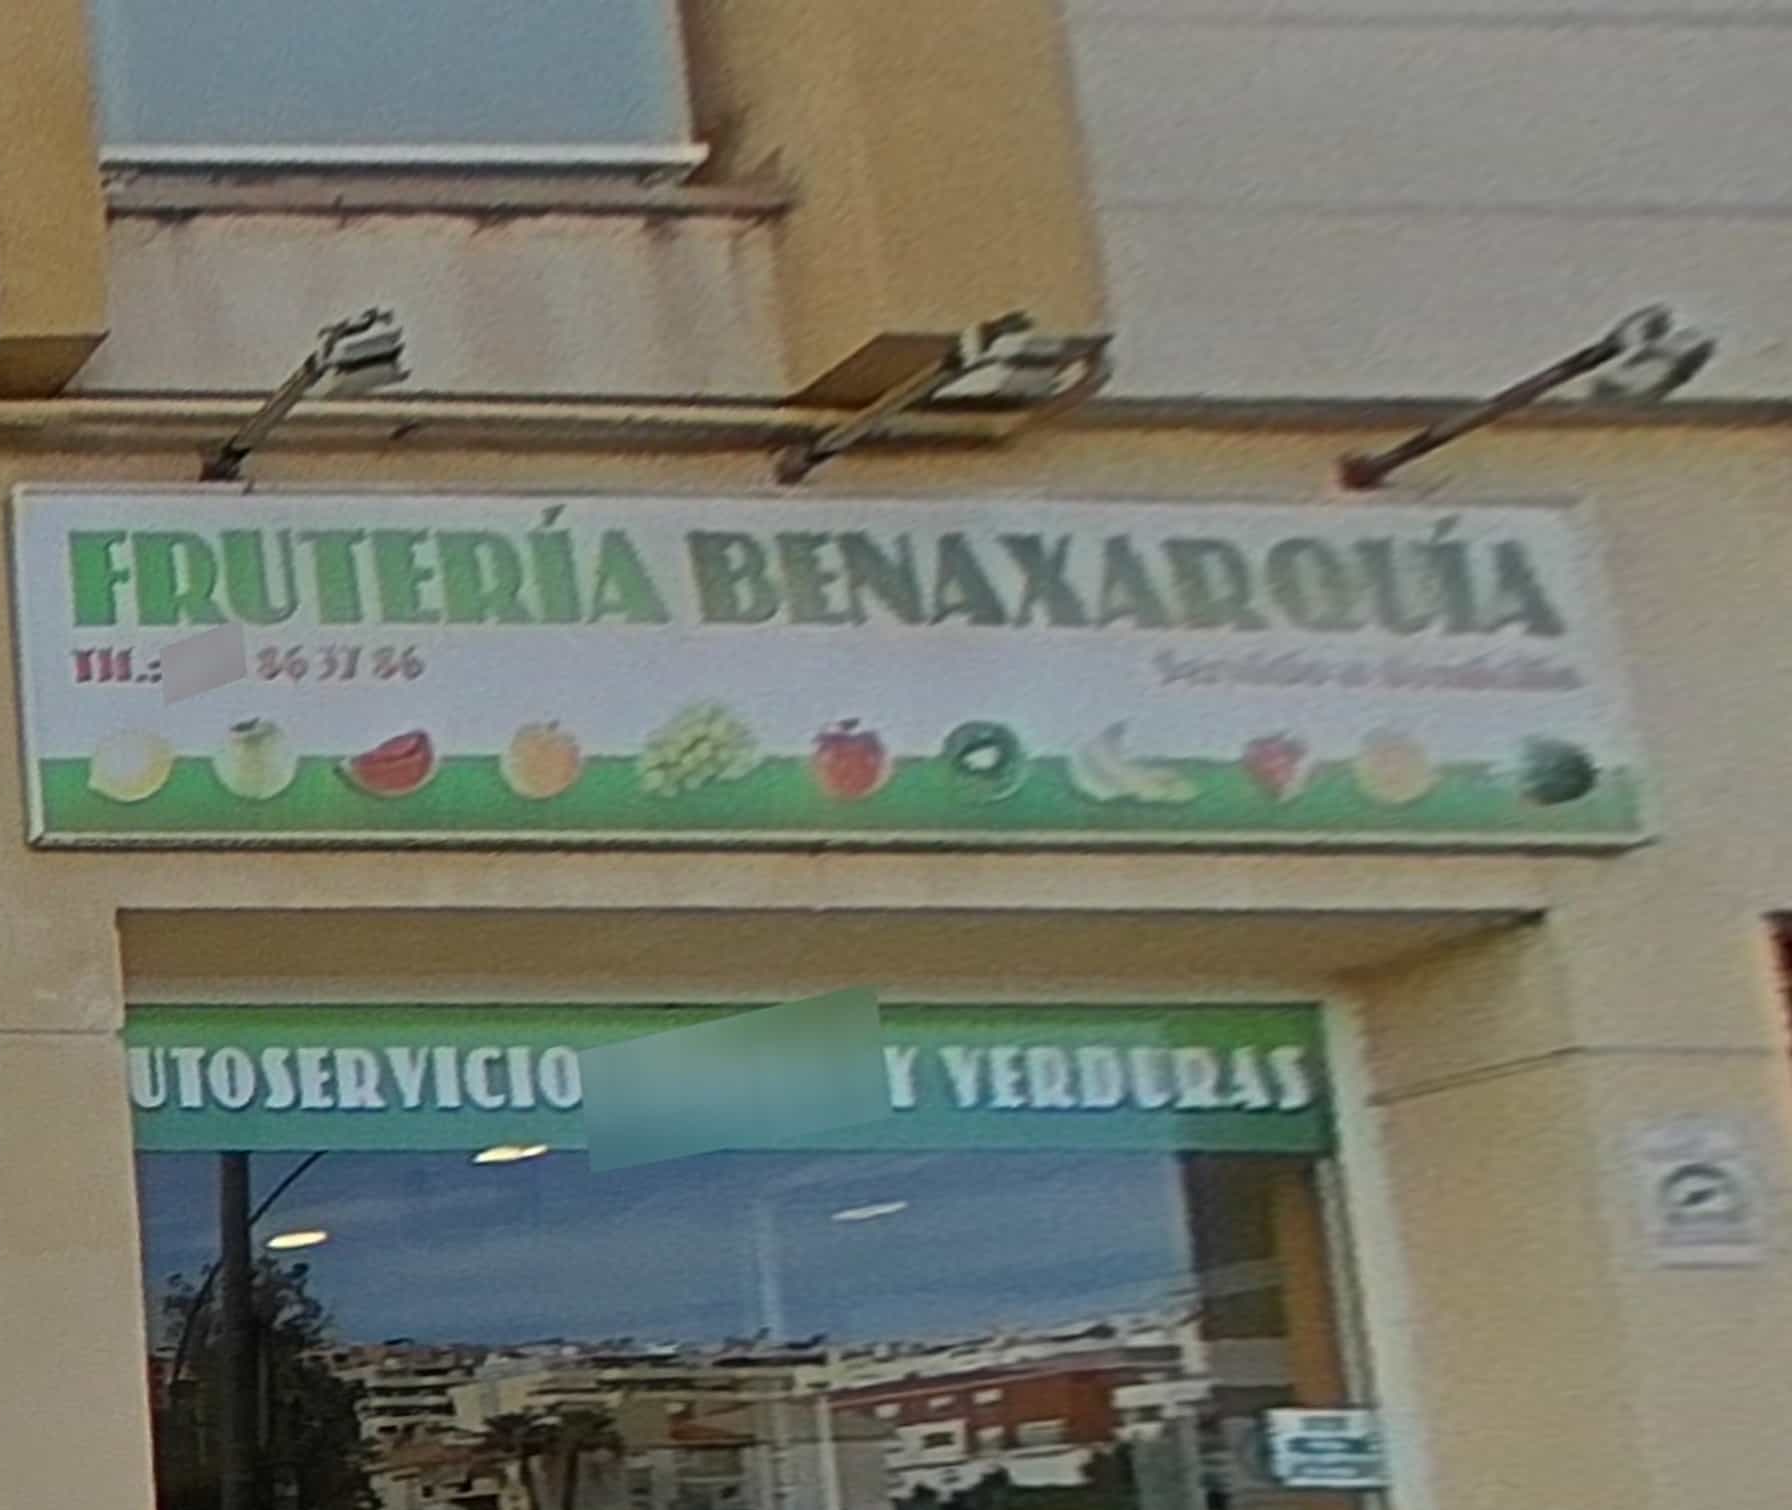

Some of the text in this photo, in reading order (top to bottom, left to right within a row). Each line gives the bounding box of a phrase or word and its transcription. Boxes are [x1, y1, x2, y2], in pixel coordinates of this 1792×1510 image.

[67, 505, 1565, 637] FRUTERÍA BENAXARQUÍA
[126, 1045, 1314, 1111] UTOSERVICIO Y VERDURAS
